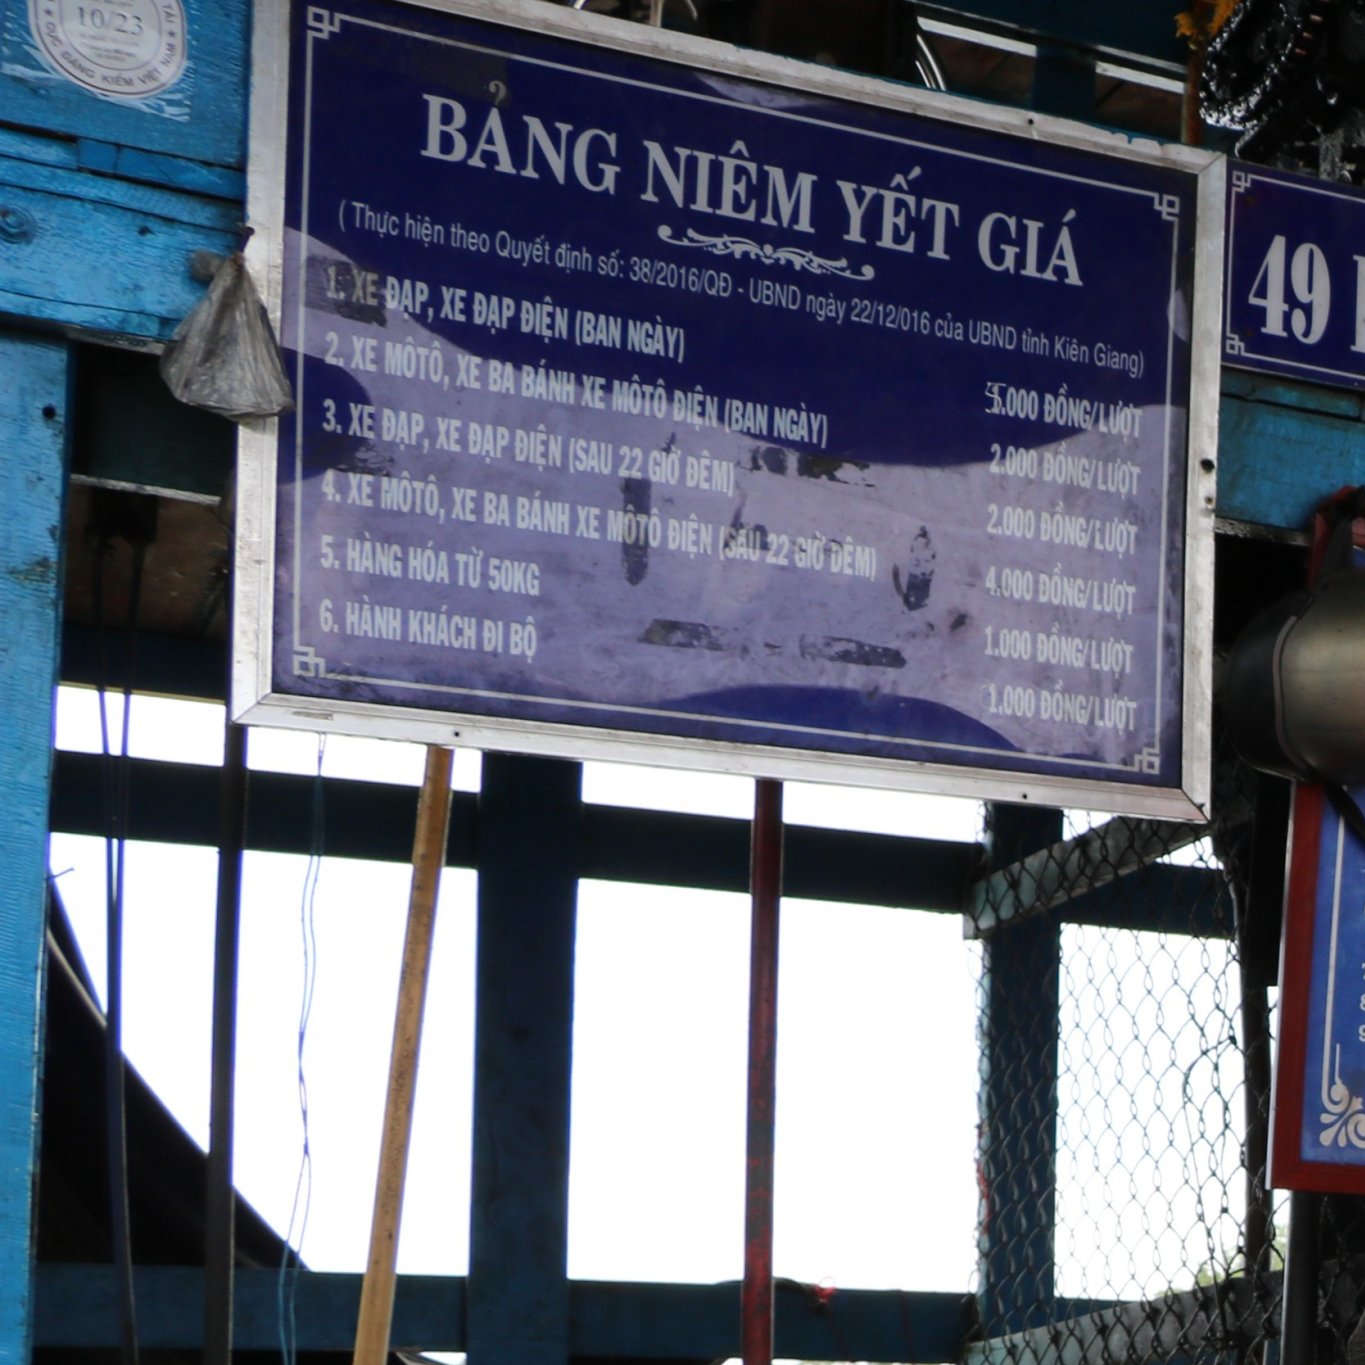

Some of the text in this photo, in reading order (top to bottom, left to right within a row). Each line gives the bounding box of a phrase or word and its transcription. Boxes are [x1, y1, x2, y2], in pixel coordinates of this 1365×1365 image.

[78, 6, 144, 36] 10/23
[101, 73, 136, 87] KIỂM
[138, 68, 162, 86] VIỆT
[161, 42, 177, 67] NAM
[421, 80, 1084, 286] BẢNG NIÊM YẾT GIÁ
[351, 269, 685, 363] XE ĐẠP, XE ĐẠP ĐIỆN (BAN NGÀY)
[404, 212, 1144, 378] hiện theo Quyết định số: 38/2016/QĐ UBND ngày 22/12/016 của UBND tỉnh Kiên Giang)
[1249, 235, 1331, 344] 49
[350, 334, 828, 449] XE MÔTÔ, XE BA BÁNH XE MÔTÔ ĐIỆN (BAN NGÀY)
[1043, 382, 1143, 443] ĐỒNG/LƯỢT
[348, 402, 735, 497] XE ĐẠP, XE ĐẠP ĐIỆN (SAU 22 GIỜ ĐÊM)
[989, 441, 1141, 500] 2.000 ĐỒNG/LƯỢT
[347, 470, 876, 581] XE MÔTÔ, XE BA BÁNH XE MÔTÔ ĐIỆN (SAU 22 GIỜ ĐÊM)
[987, 500, 1138, 560] 2.000 ĐỒNG/LƯỢT
[347, 531, 540, 596] HÀNG HÓA TỪ 50KG
[985, 562, 1136, 620] 4.000 ĐỒNG/LƯỢT
[346, 595, 537, 664] HÀNH KHÁCH ĐI BỘ
[984, 622, 1133, 679] 1.000 ĐỒNG/LƯỢT
[988, 679, 1137, 736] 1.000 ĐỒNG/LƯỢT
